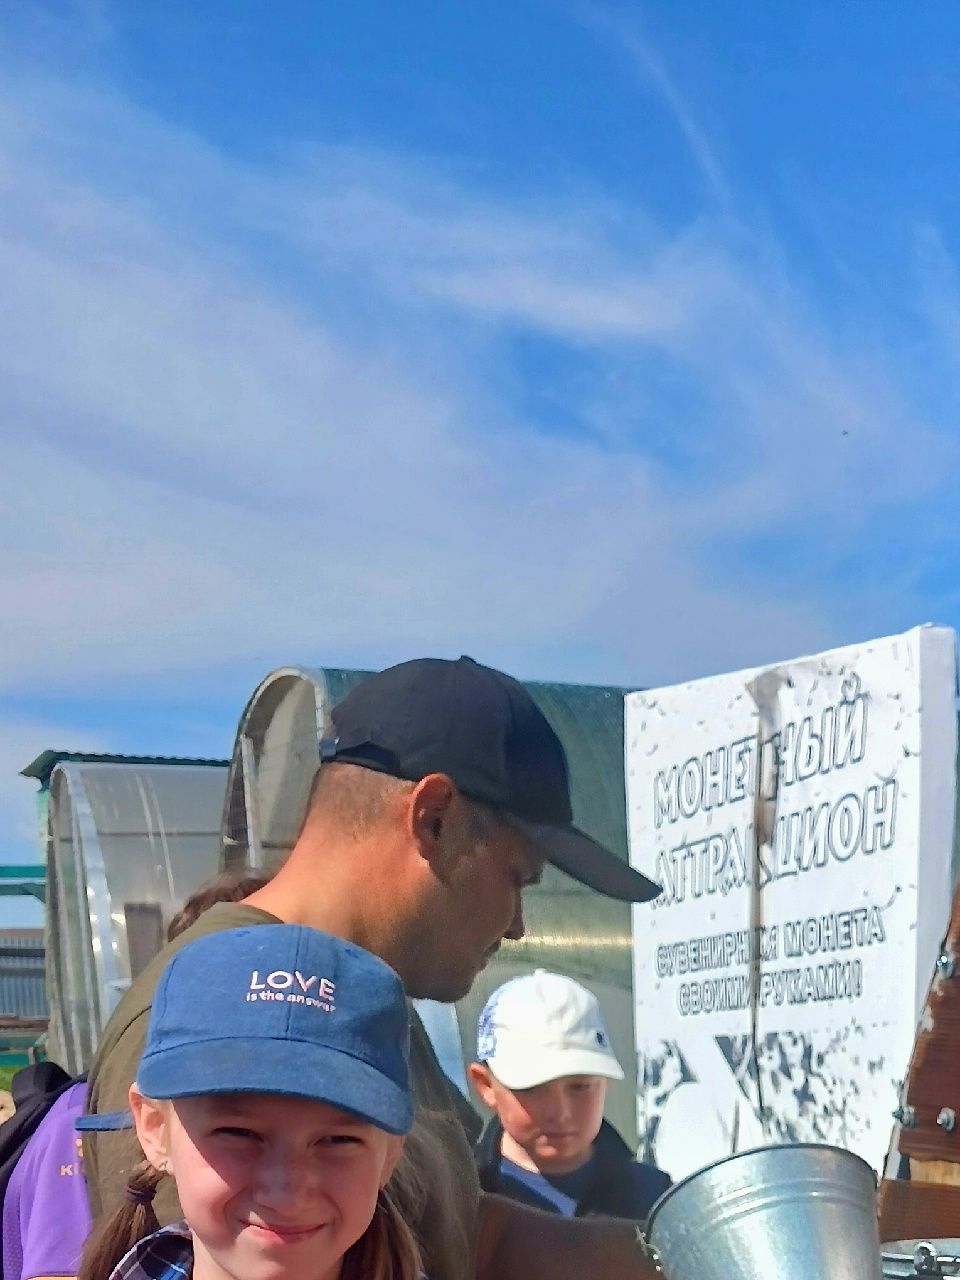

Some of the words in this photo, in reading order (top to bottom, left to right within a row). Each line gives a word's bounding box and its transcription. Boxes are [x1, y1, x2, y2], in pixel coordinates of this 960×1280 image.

[656, 924, 780, 978] СУВЕНИРНЯ
[784, 905, 886, 958] МОНЕТА
[250, 970, 335, 1001] LOVE
[259, 990, 285, 1001] the
